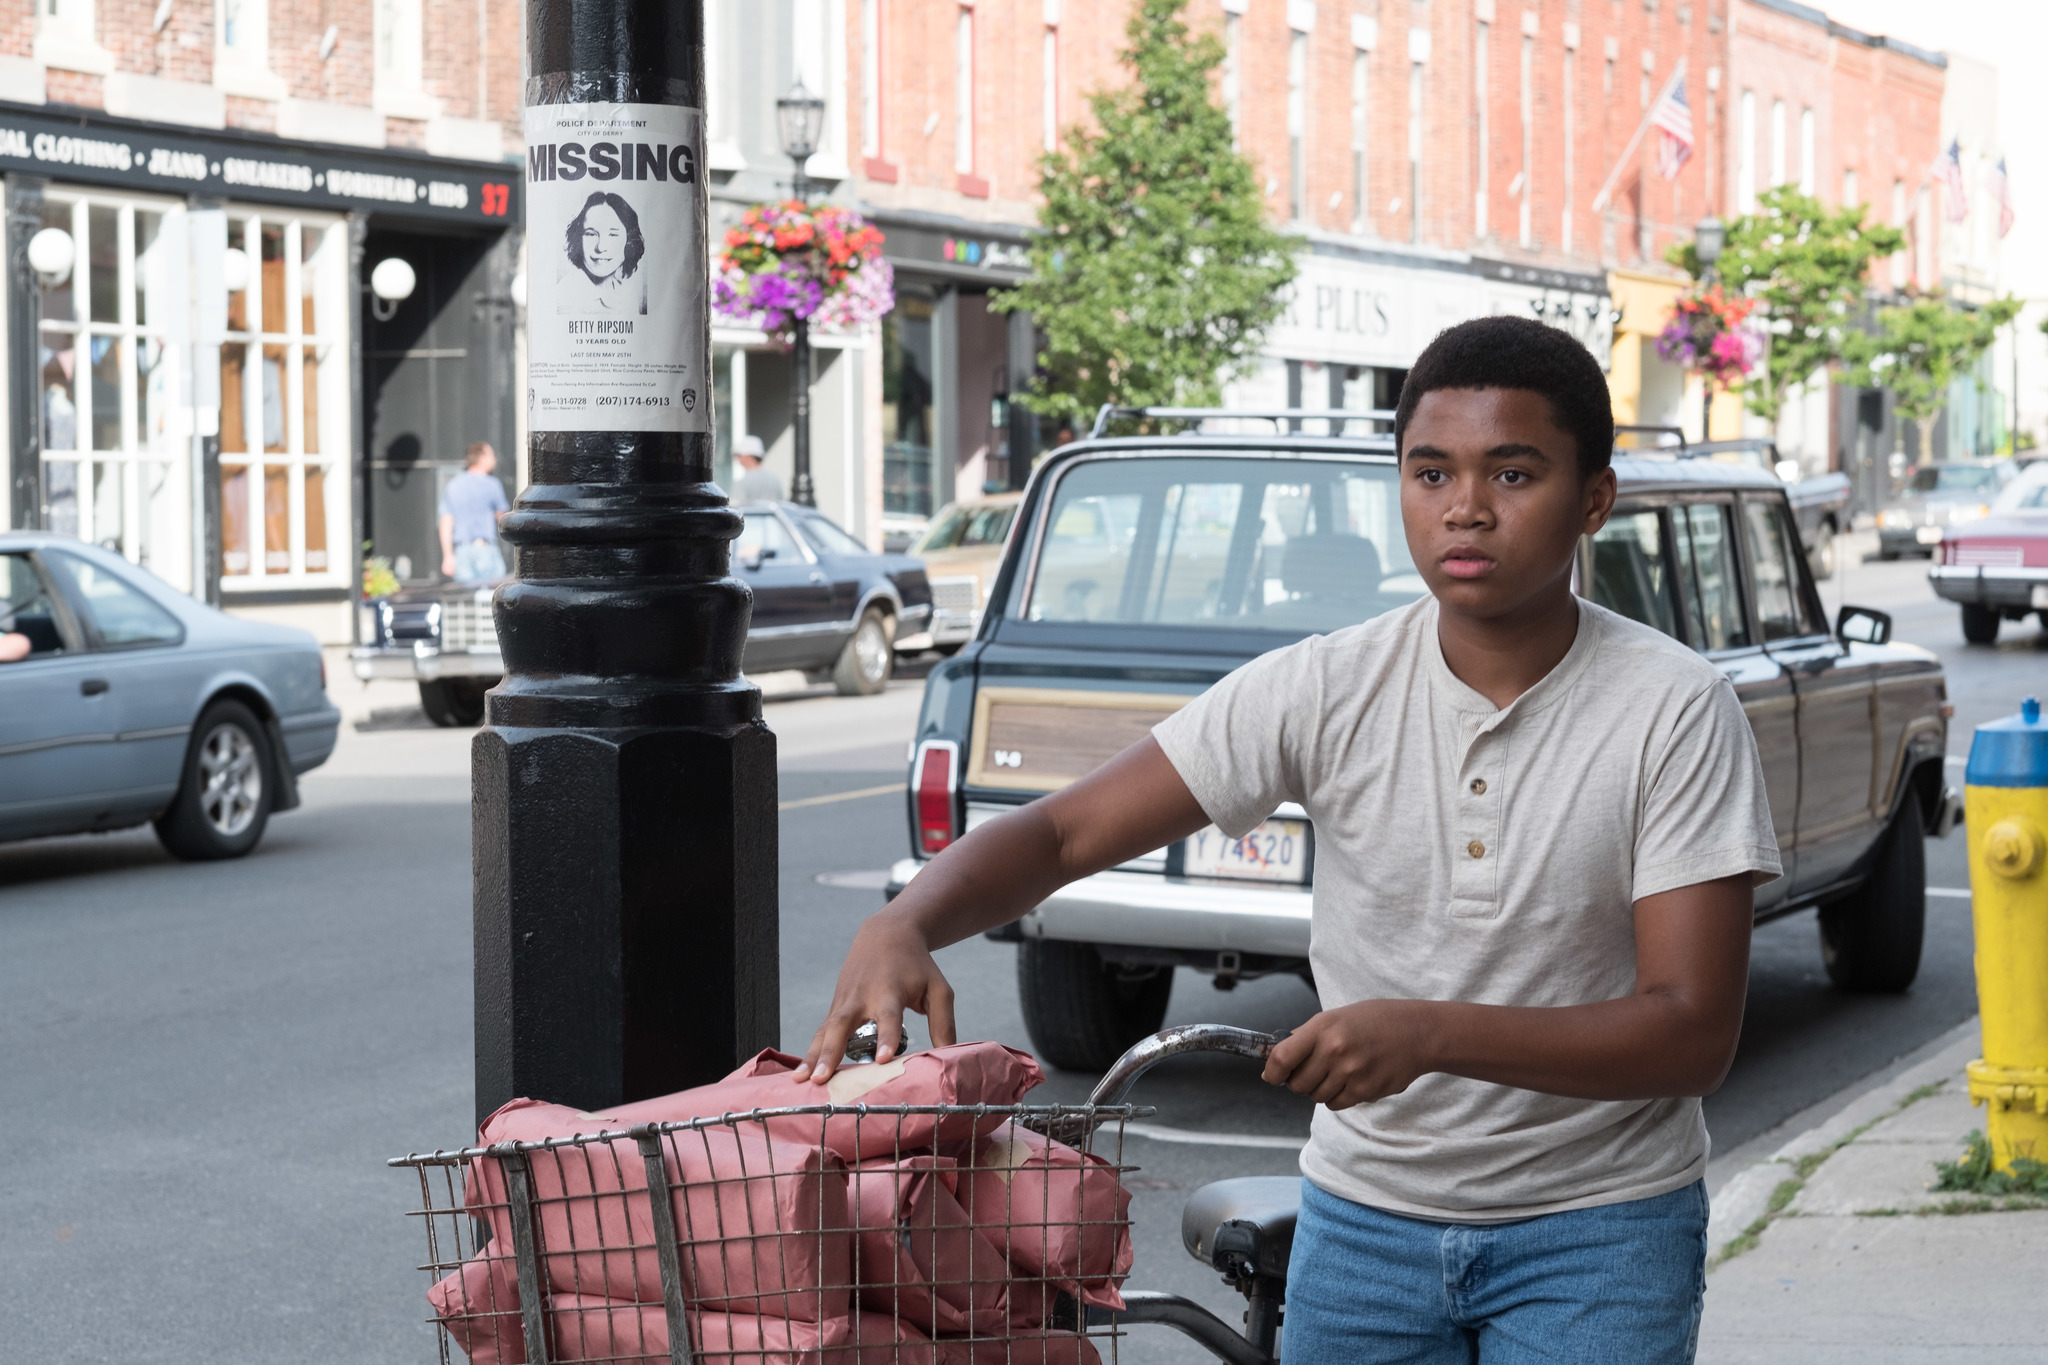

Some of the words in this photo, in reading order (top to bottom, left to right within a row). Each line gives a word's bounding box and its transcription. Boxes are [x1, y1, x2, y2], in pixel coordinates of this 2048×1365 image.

[33, 132, 132, 171] CLOTHING
[147, 148, 207, 181] JEANS
[480, 182, 510, 217] 37
[528, 142, 695, 184] MISSING
[568, 320, 594, 334] BETTY
[597, 320, 633, 334] RIPSOM
[1316, 284, 1389, 337] PLUS
[595, 396, 670, 407] (207)174-6913
